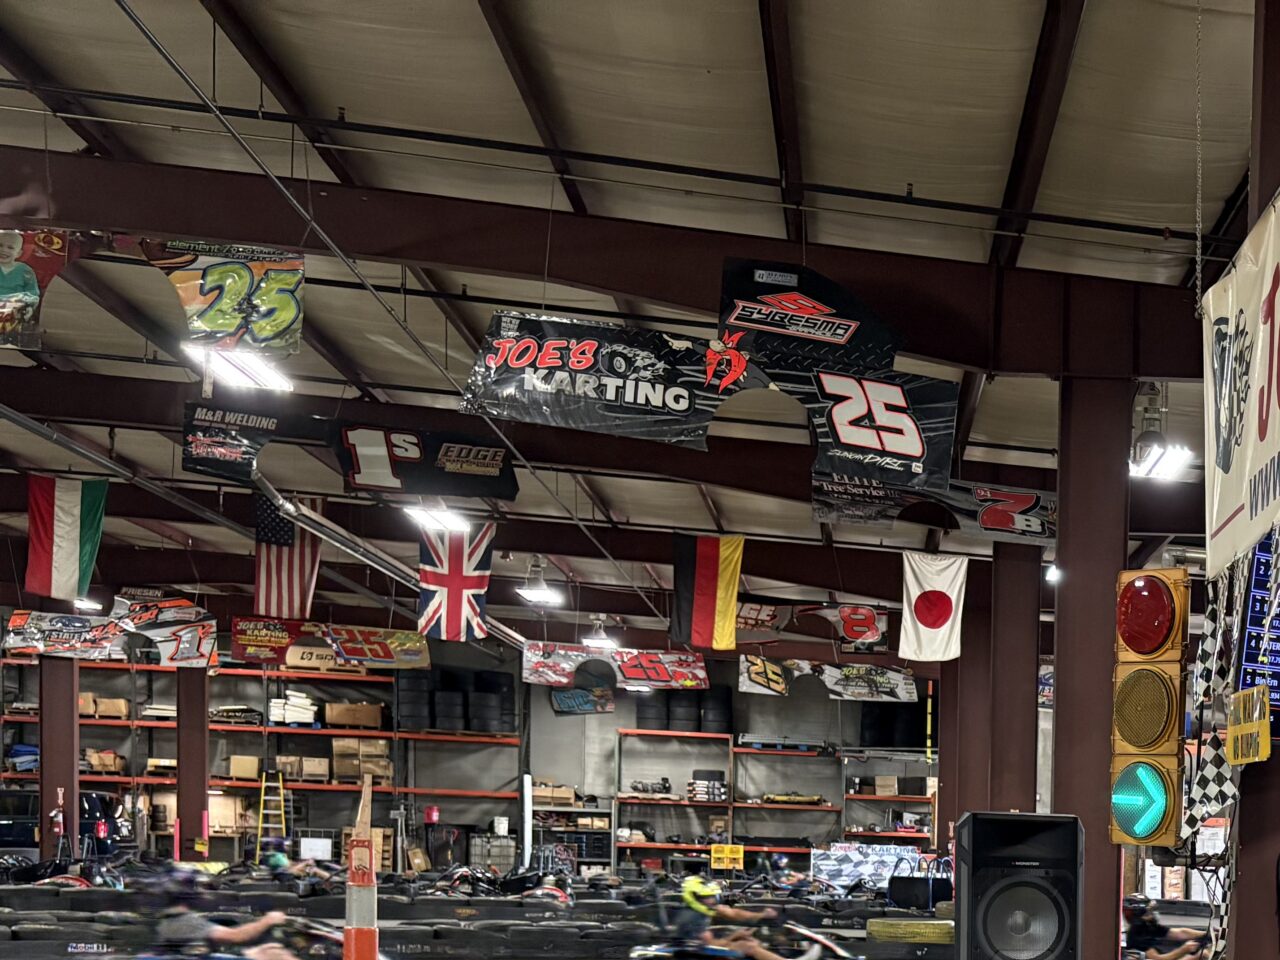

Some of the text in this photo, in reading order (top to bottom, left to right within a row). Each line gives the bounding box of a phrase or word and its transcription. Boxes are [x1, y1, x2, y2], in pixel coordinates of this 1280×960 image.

[199, 261, 301, 343] 25
[485, 338, 599, 371] JOE'S
[523, 367, 691, 413] KARTING
[224, 412, 278, 430] WELDING
[817, 372, 925, 459] 25
[822, 481, 845, 492] Tree
[846, 484, 885, 497] Service
[838, 604, 882, 642] 8
[329, 626, 397, 660] 25
[614, 652, 673, 682] 25
[871, 846, 917, 854] KARTING
